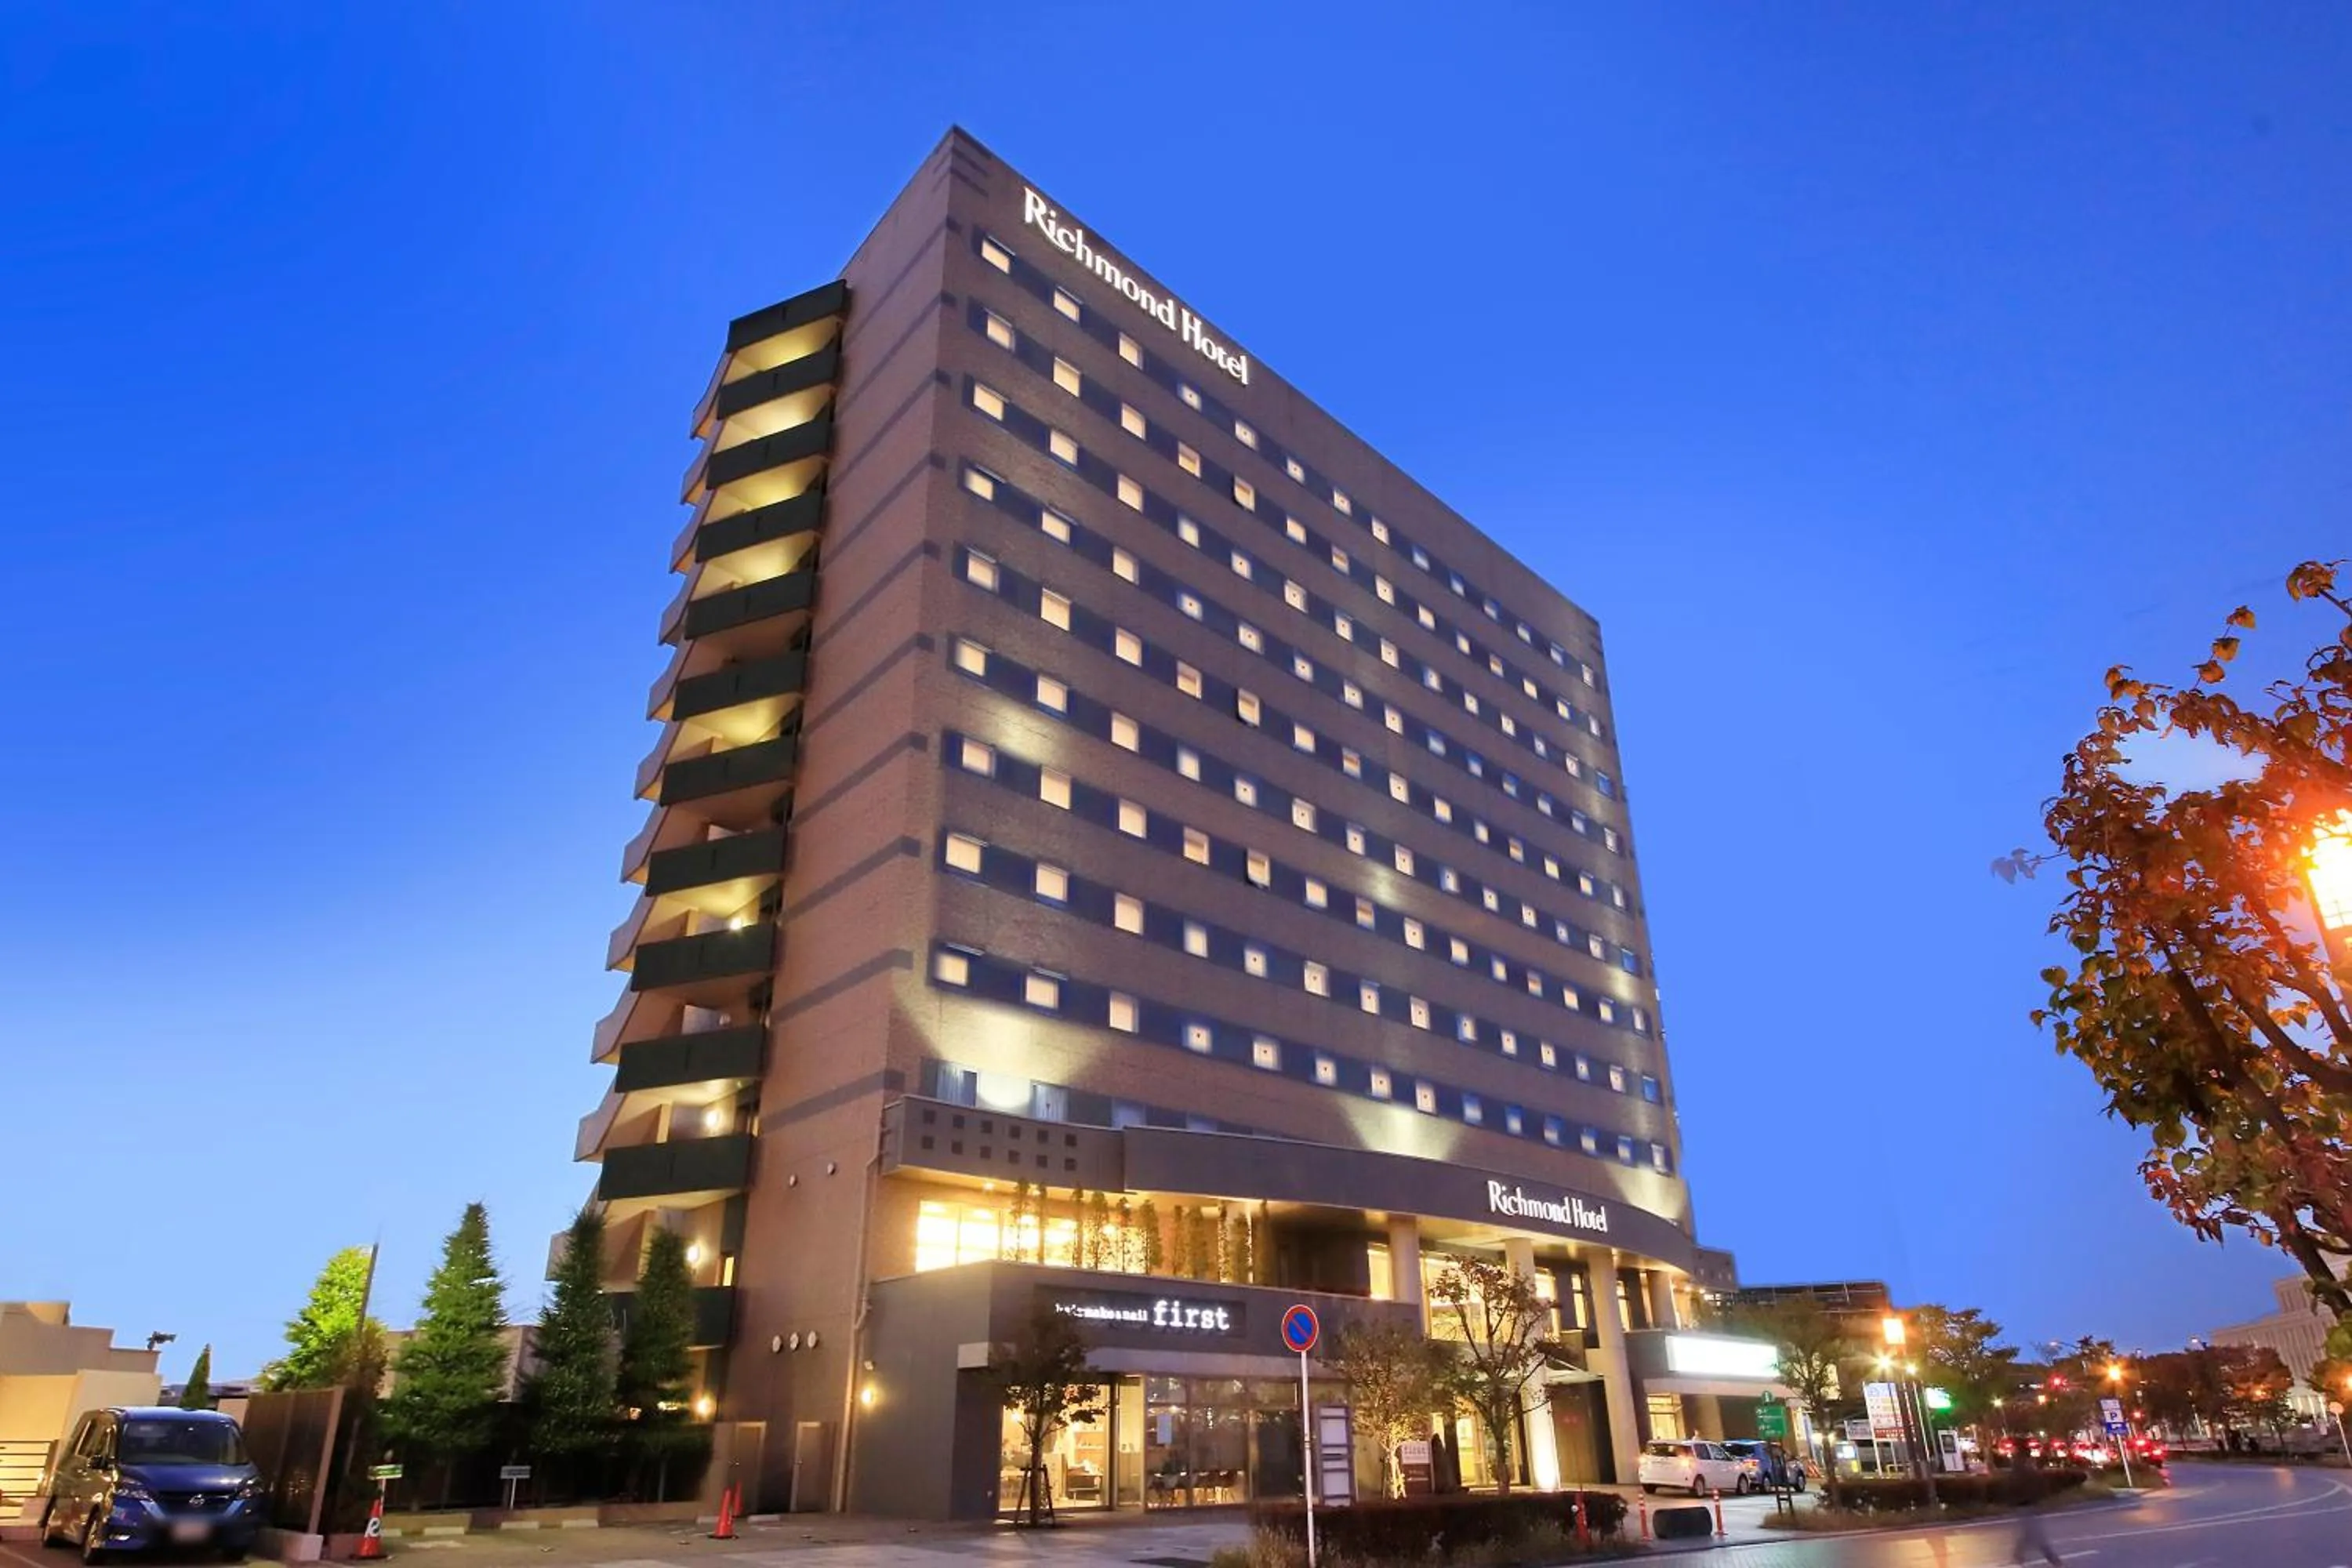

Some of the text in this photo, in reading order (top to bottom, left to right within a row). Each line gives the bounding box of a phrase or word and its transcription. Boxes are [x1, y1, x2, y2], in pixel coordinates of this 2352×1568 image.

[1024, 186, 1249, 386] Richmond Hotel
[1487, 1180, 1608, 1233] Richmond Hotel
[1152, 1299, 1230, 1331] first
